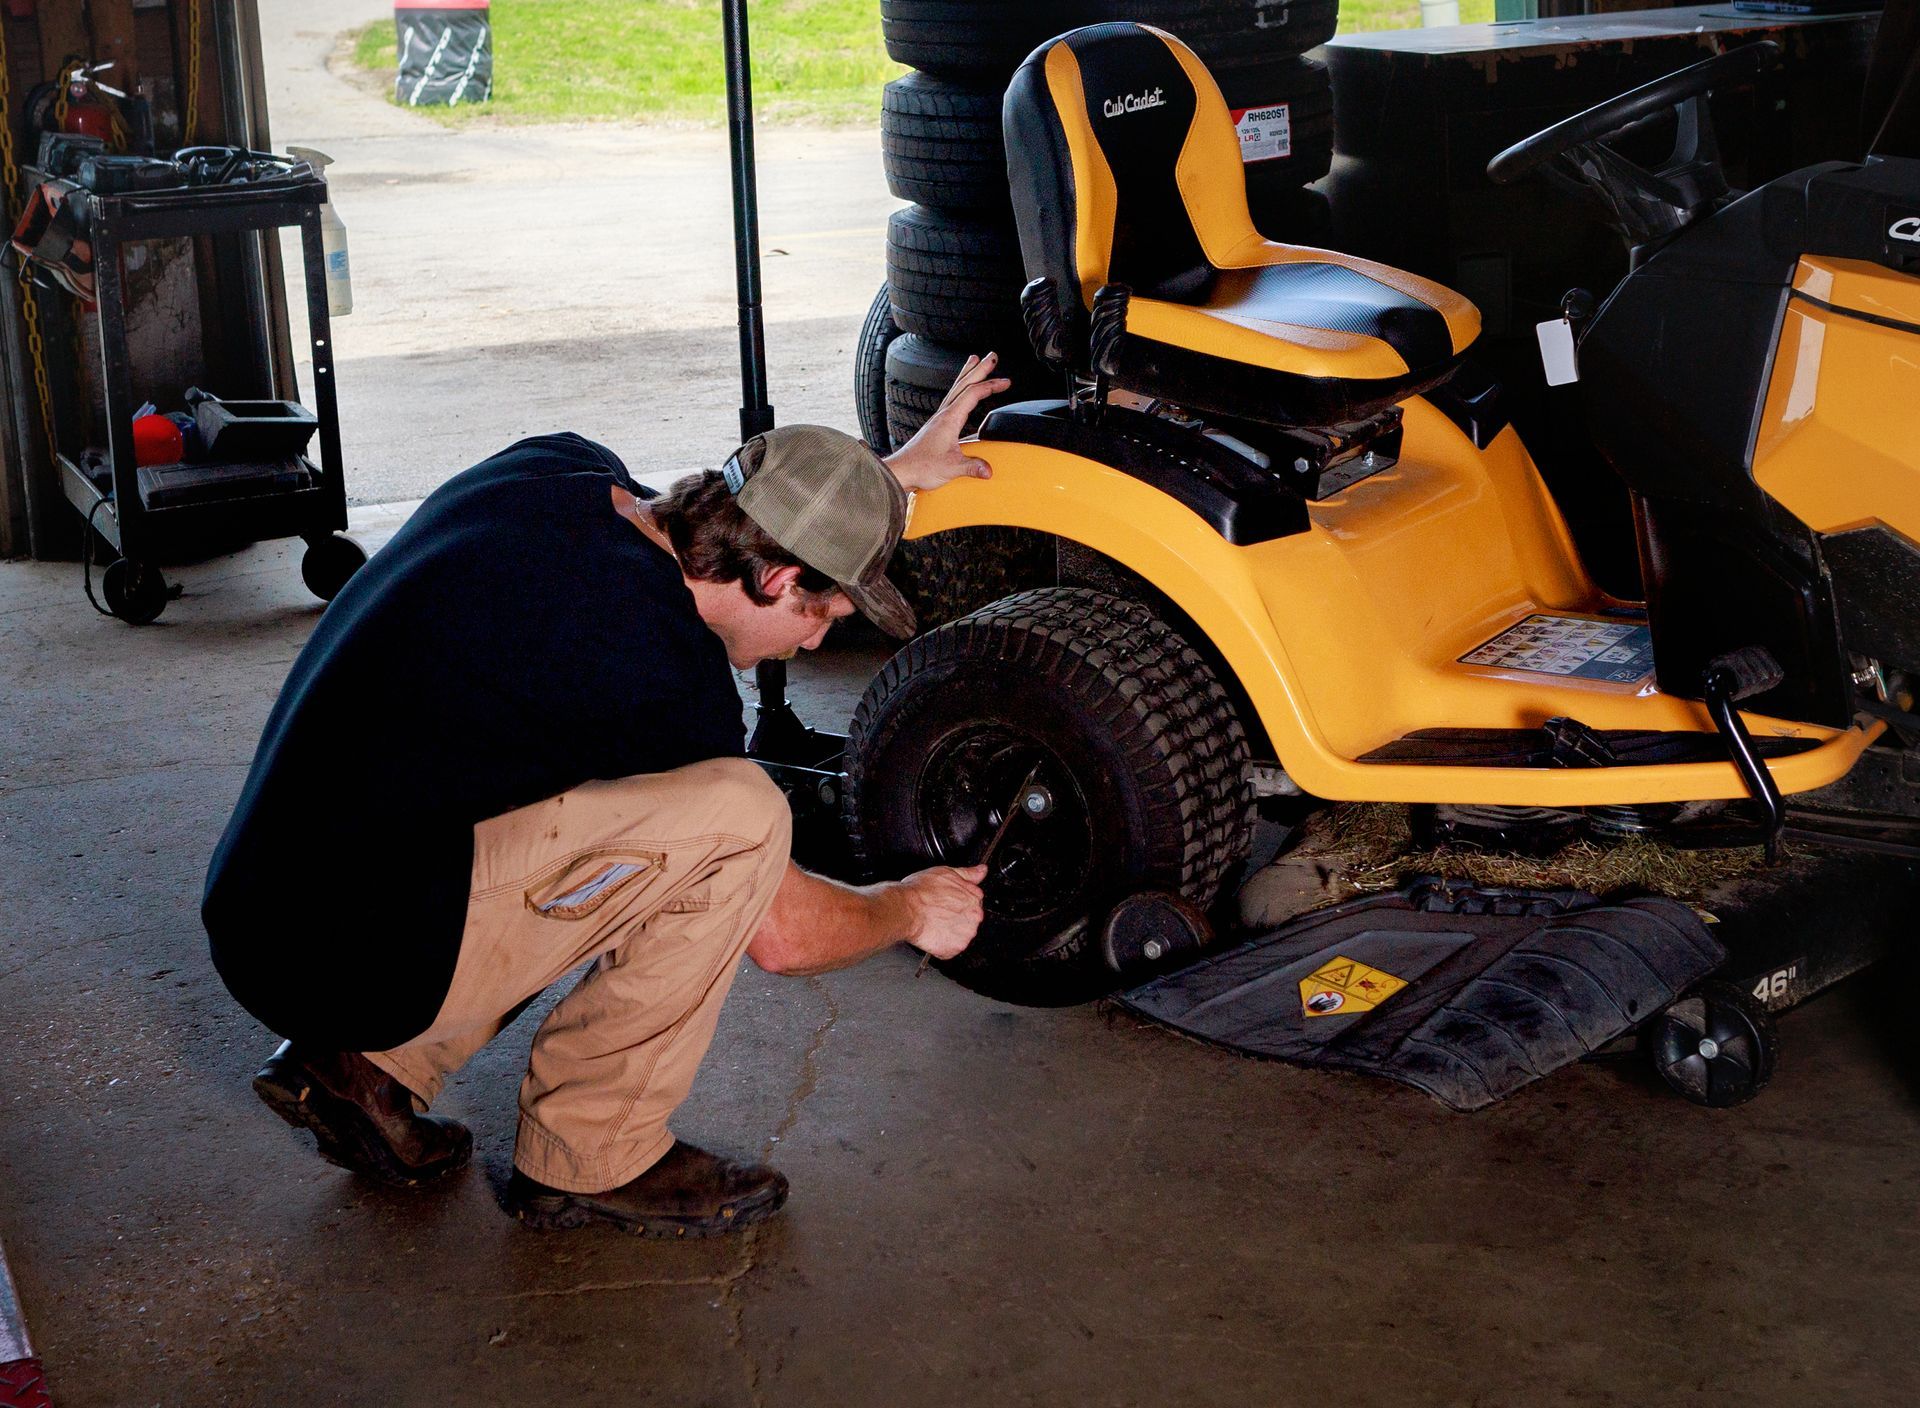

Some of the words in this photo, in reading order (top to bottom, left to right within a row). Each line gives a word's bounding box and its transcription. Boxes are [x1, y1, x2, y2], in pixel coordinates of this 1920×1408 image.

[1103, 95, 1125, 118] Cub
[1124, 86, 1165, 113] Cadet
[1247, 108, 1286, 122] RH620ST
[1751, 966, 1797, 1003] 46"
